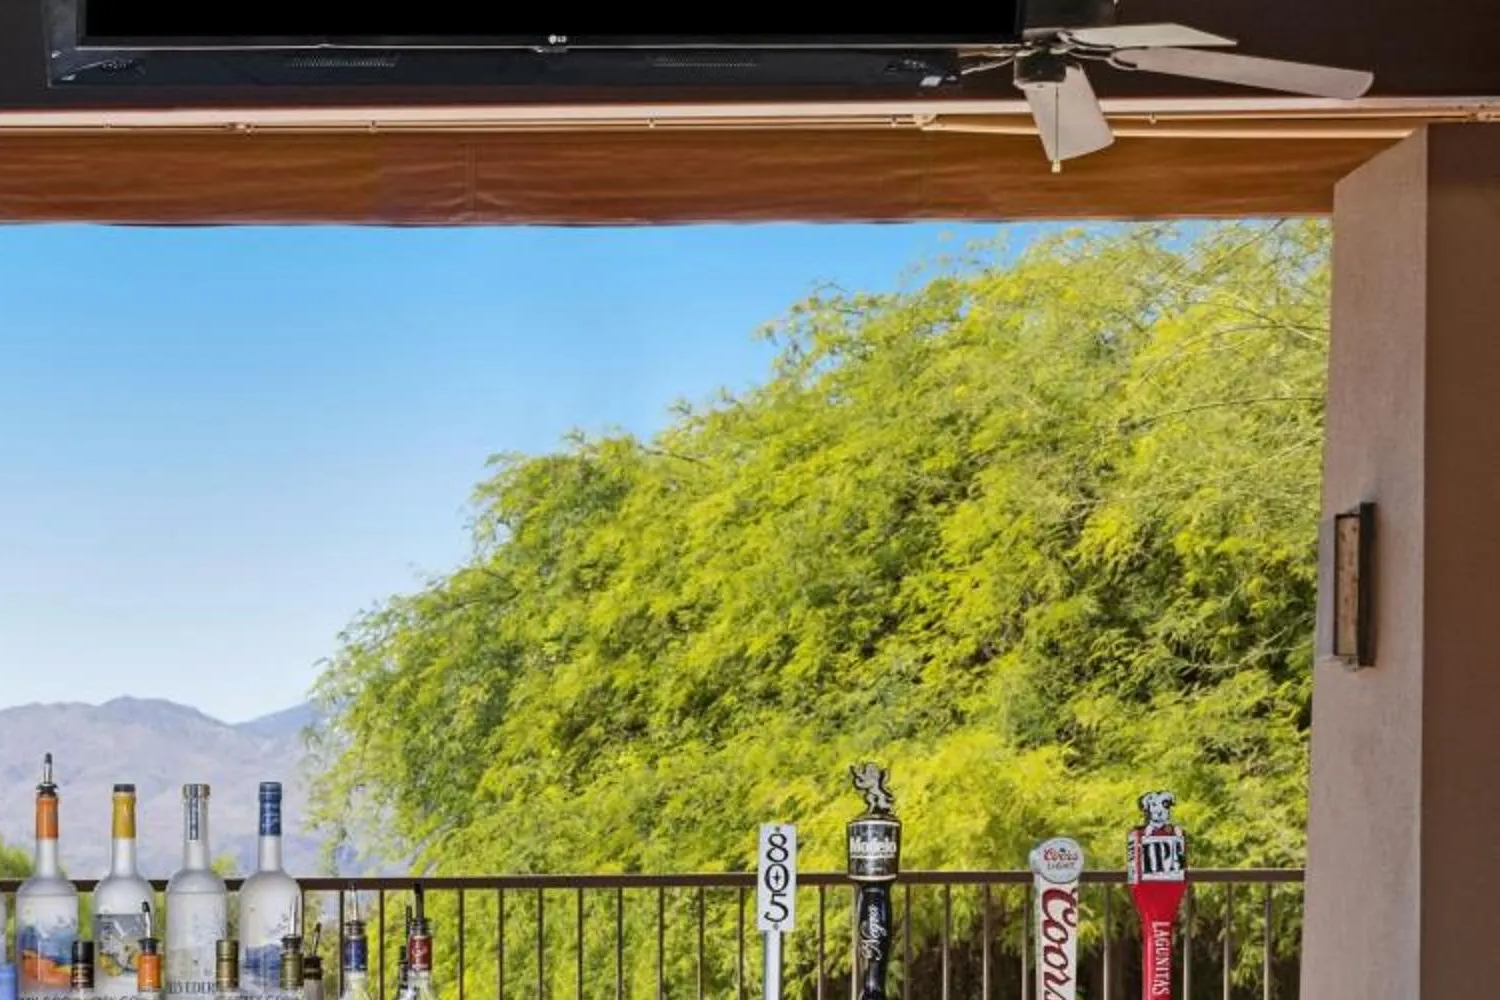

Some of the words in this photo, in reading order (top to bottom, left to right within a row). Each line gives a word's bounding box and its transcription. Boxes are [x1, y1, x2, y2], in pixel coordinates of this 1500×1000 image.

[764, 833, 789, 922] 805
[1142, 840, 1186, 874] IPA
[1152, 921, 1172, 996] LAGUNITAS
